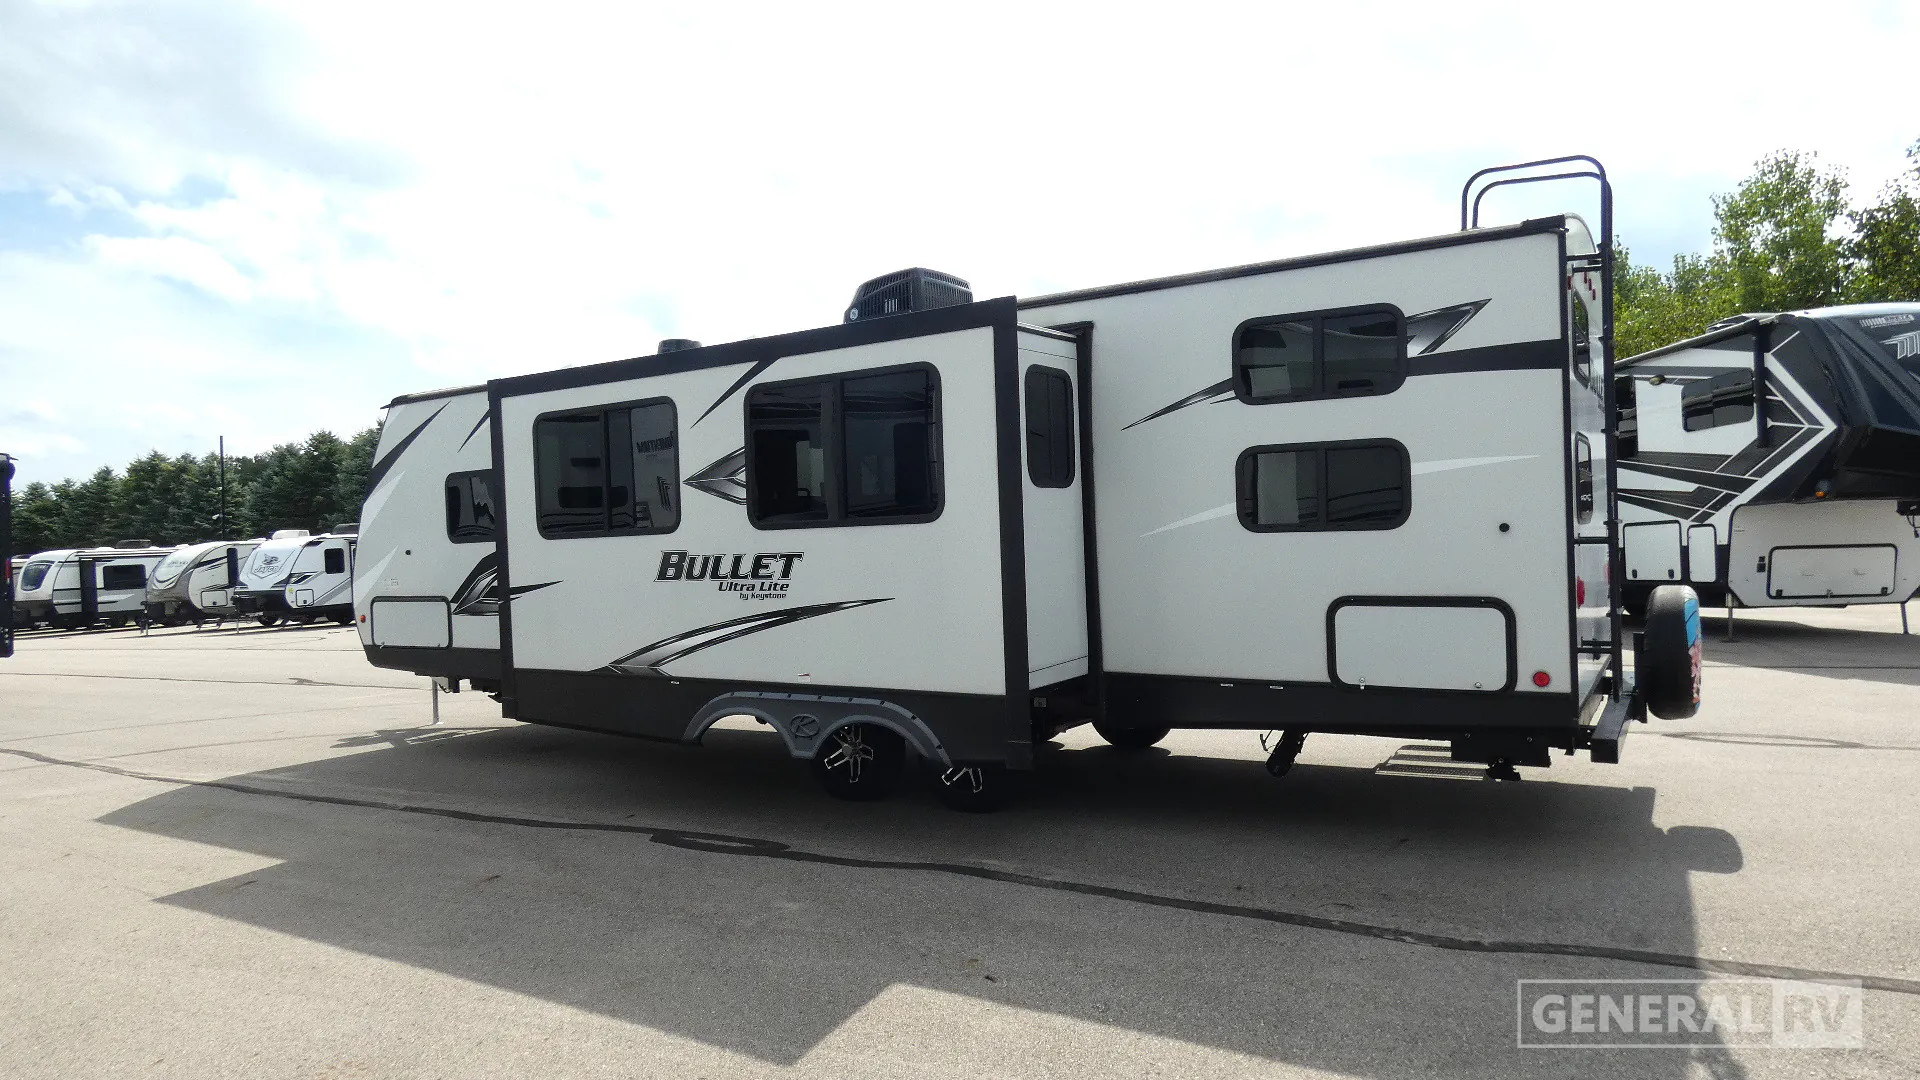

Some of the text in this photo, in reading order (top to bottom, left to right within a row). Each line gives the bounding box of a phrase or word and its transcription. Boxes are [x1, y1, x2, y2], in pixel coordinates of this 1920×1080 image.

[654, 550, 804, 581] BULLET
[718, 582, 789, 592] Ultra Lite
[740, 592, 787, 600] by Keystone
